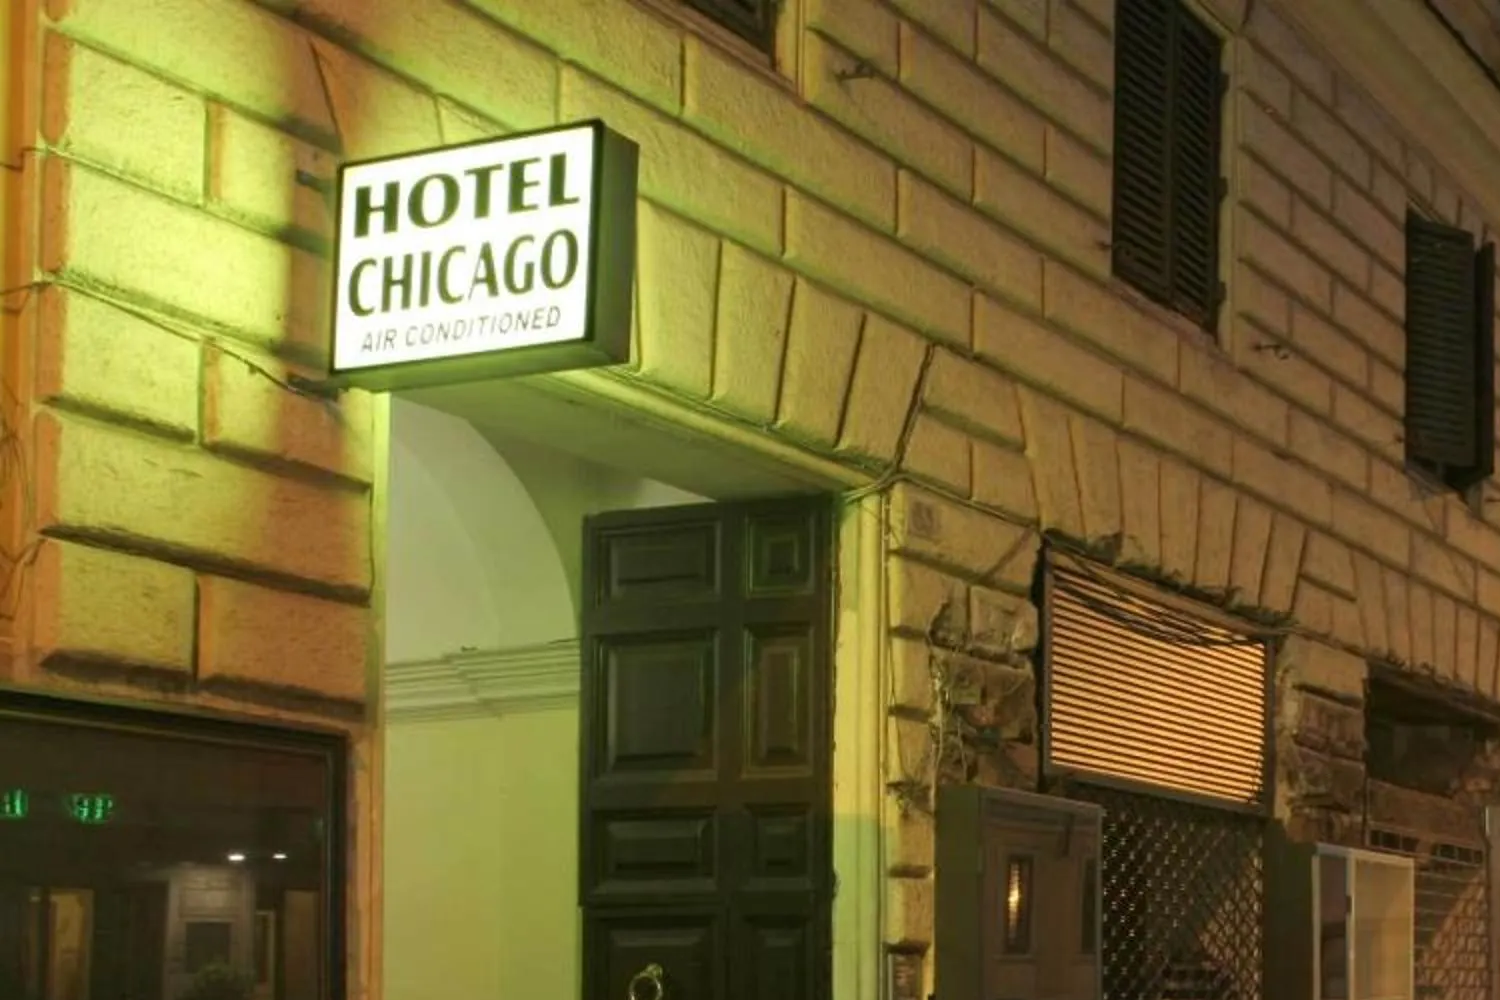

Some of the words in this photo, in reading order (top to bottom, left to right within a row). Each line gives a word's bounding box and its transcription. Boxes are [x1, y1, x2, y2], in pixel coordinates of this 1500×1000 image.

[353, 152, 581, 238] HOTEL
[347, 228, 579, 317] CHICAGO
[360, 328, 398, 353] AIR
[404, 305, 562, 348] CONDITIONED
